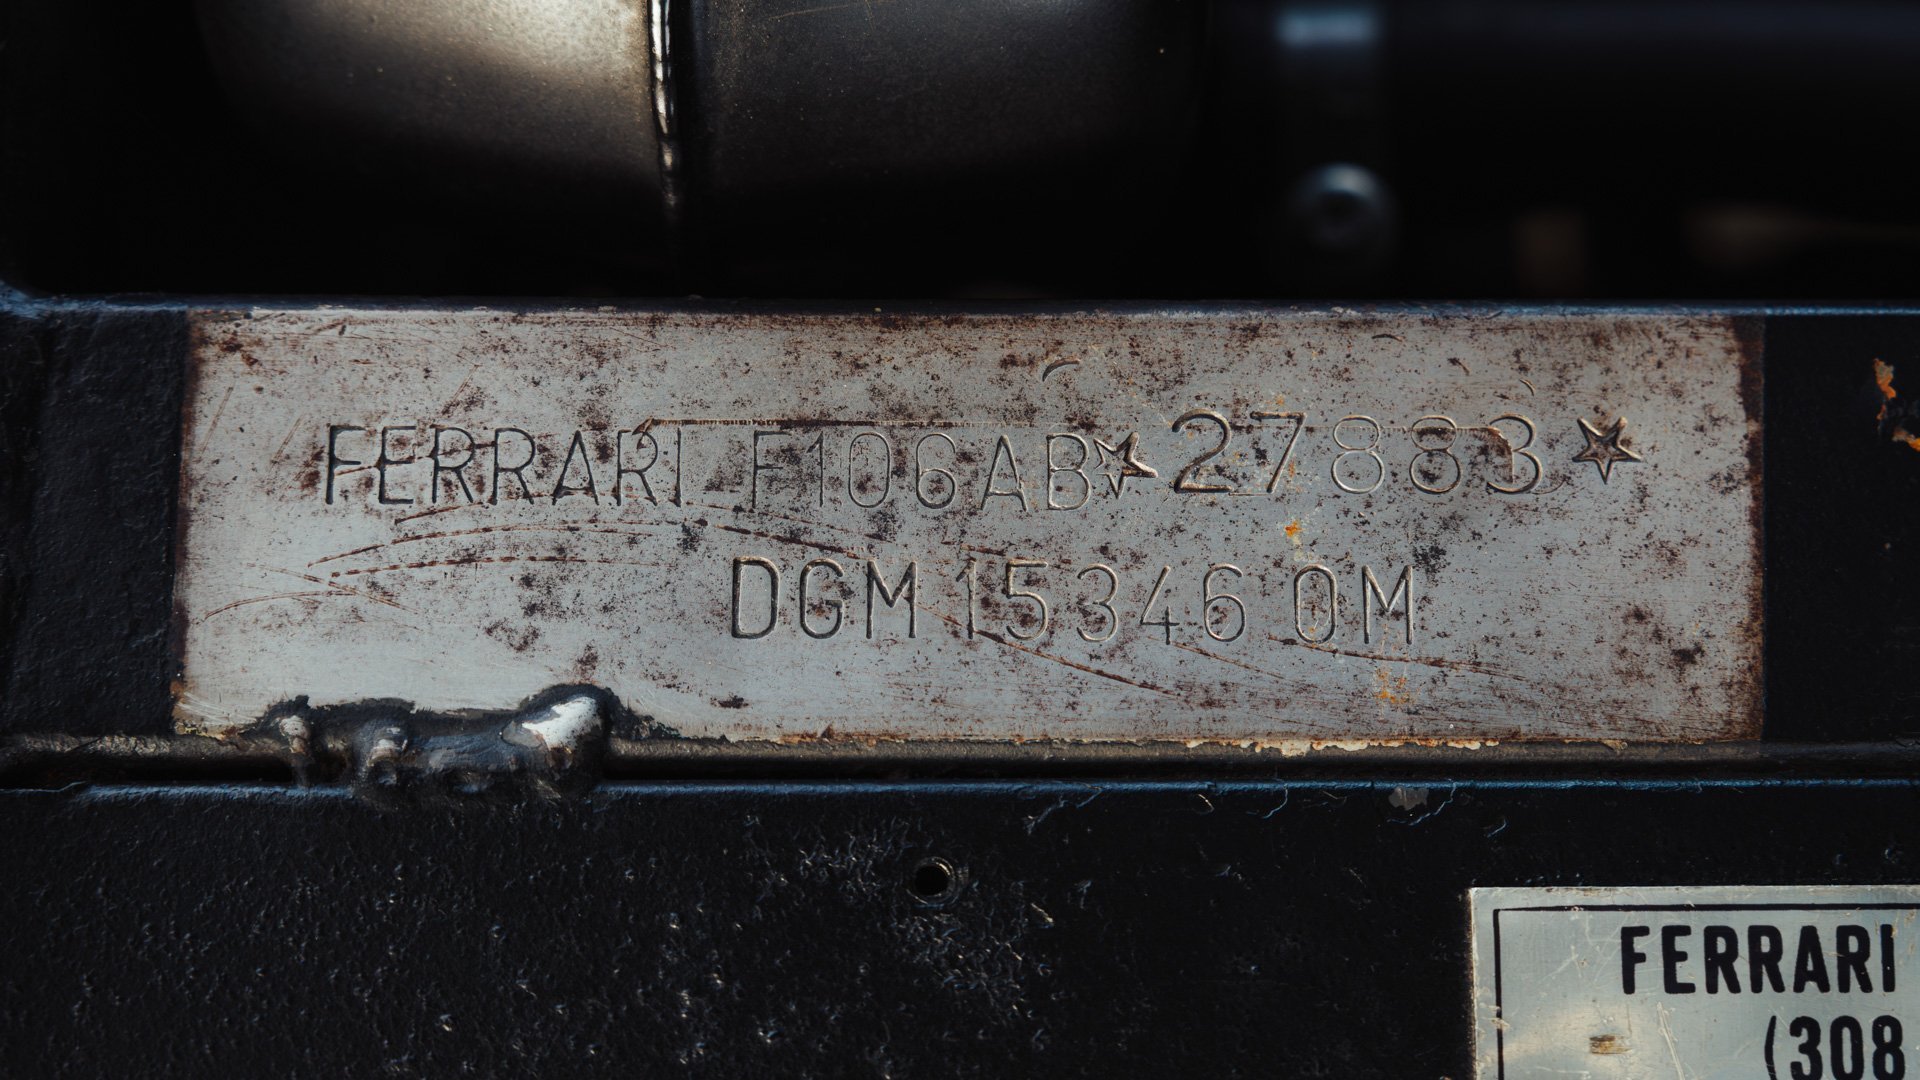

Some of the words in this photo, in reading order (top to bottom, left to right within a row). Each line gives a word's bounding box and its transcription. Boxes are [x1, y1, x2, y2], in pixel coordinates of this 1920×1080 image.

[325, 423, 682, 507] FERRARI
[753, 430, 1092, 512] F106AB
[1171, 409, 1543, 495] 27883
[731, 556, 918, 640] DGM
[955, 559, 1247, 645] 15346
[1620, 923, 1896, 995] FERRARI
[1763, 1014, 1906, 1080] (308
